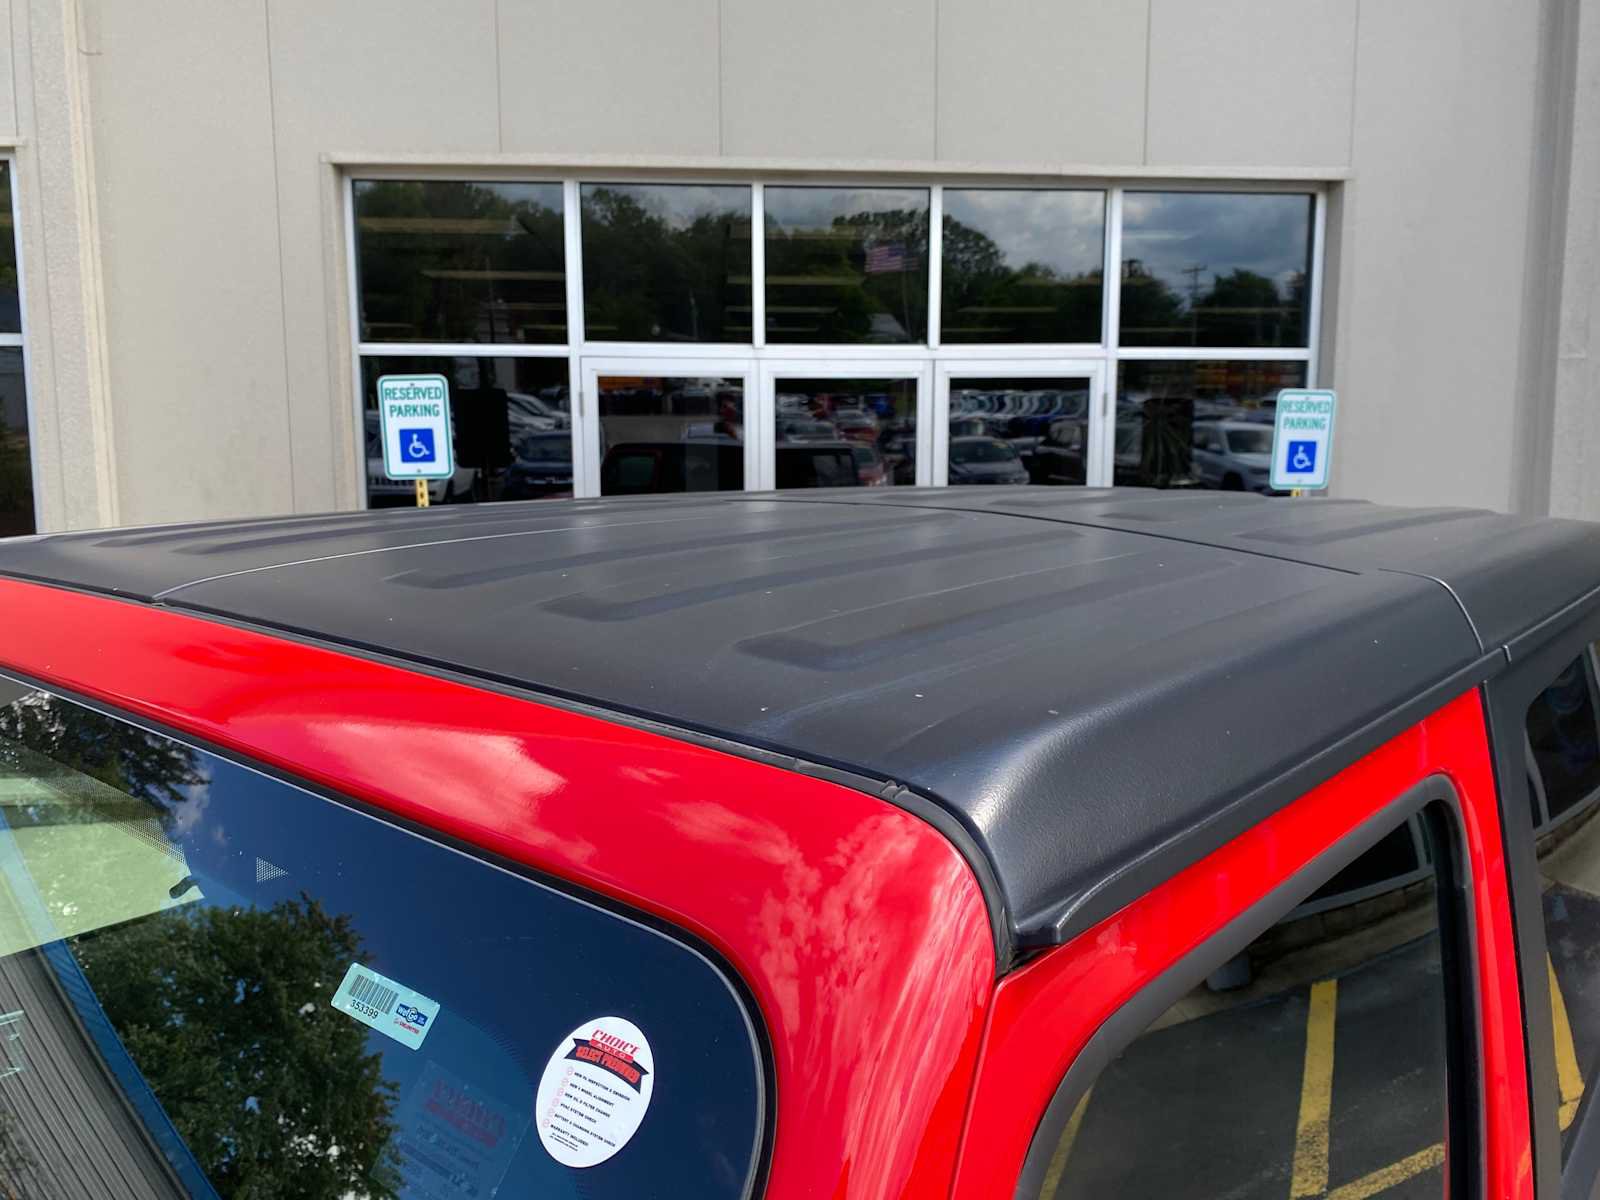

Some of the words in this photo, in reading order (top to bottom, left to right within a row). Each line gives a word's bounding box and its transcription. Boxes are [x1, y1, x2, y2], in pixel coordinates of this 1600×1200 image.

[384, 386, 442, 400] RESERVED
[389, 403, 440, 417] PARKING
[1280, 400, 1330, 413] RESERVED
[1283, 416, 1326, 430] PARKING
[350, 999, 379, 1020] 353399
[592, 1029, 640, 1054] CHOICE
[596, 1042, 626, 1059] AUTO
[550, 1124, 570, 1137] WARRANTY
